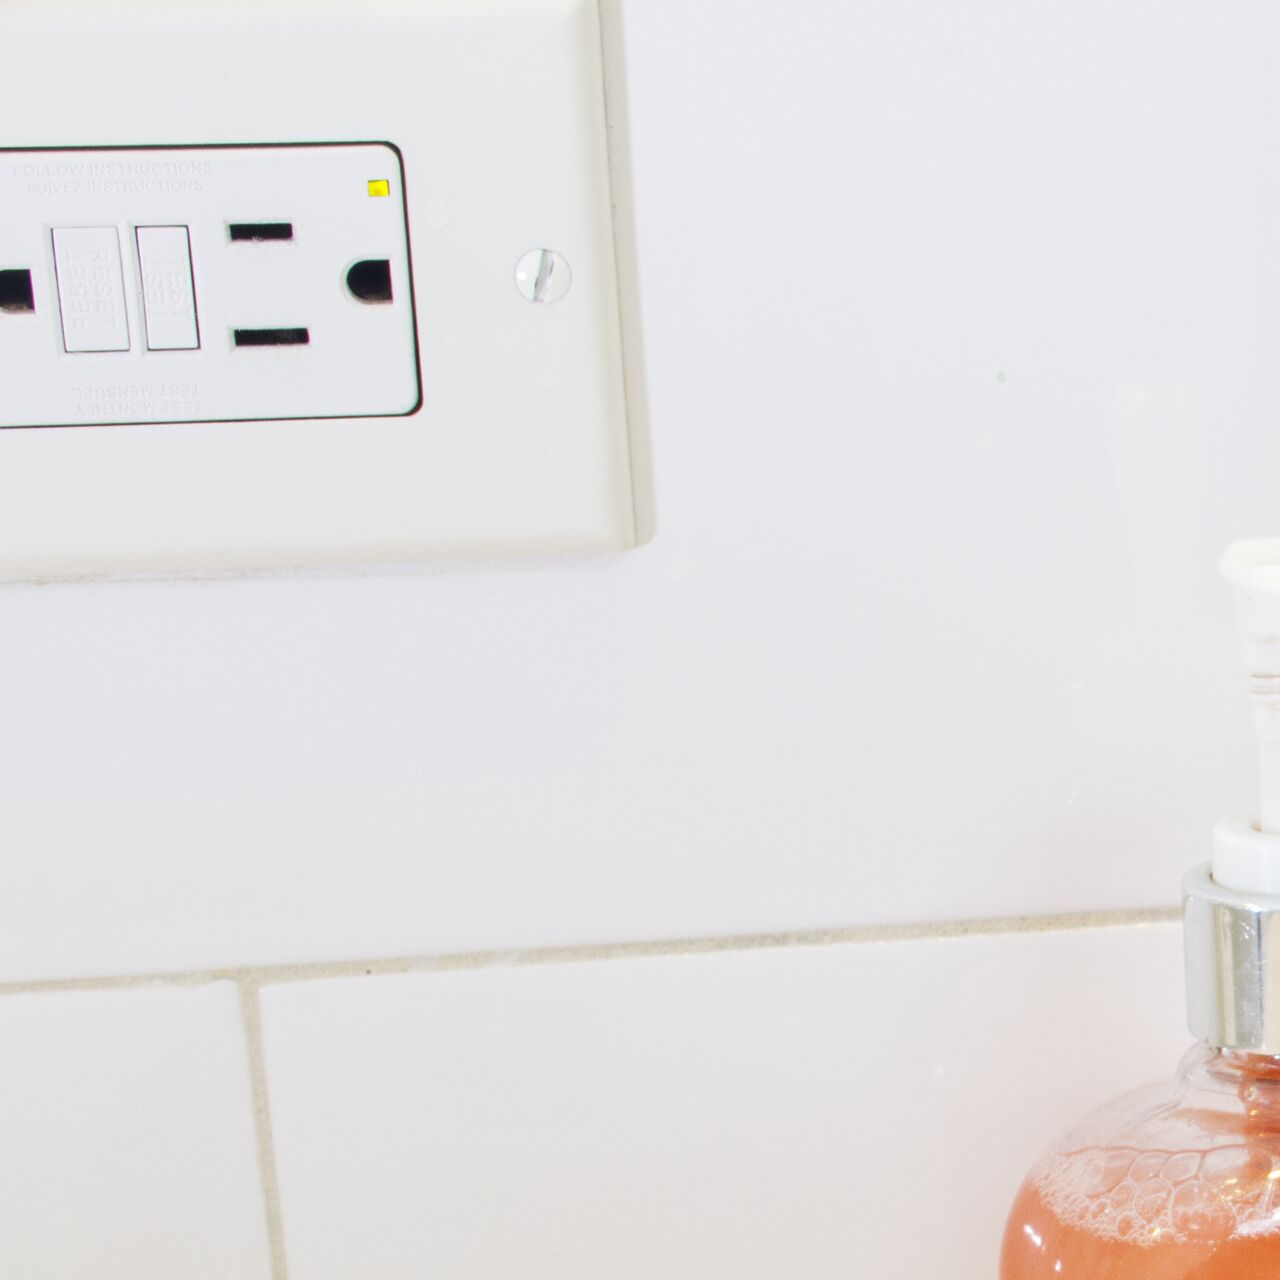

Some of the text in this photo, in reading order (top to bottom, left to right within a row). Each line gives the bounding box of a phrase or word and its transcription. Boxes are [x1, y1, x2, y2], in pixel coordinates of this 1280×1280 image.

[12, 161, 214, 178] FOLLOW INSTRUCTIONS
[25, 179, 205, 195] SUIVEZ INSTRUCTIONS
